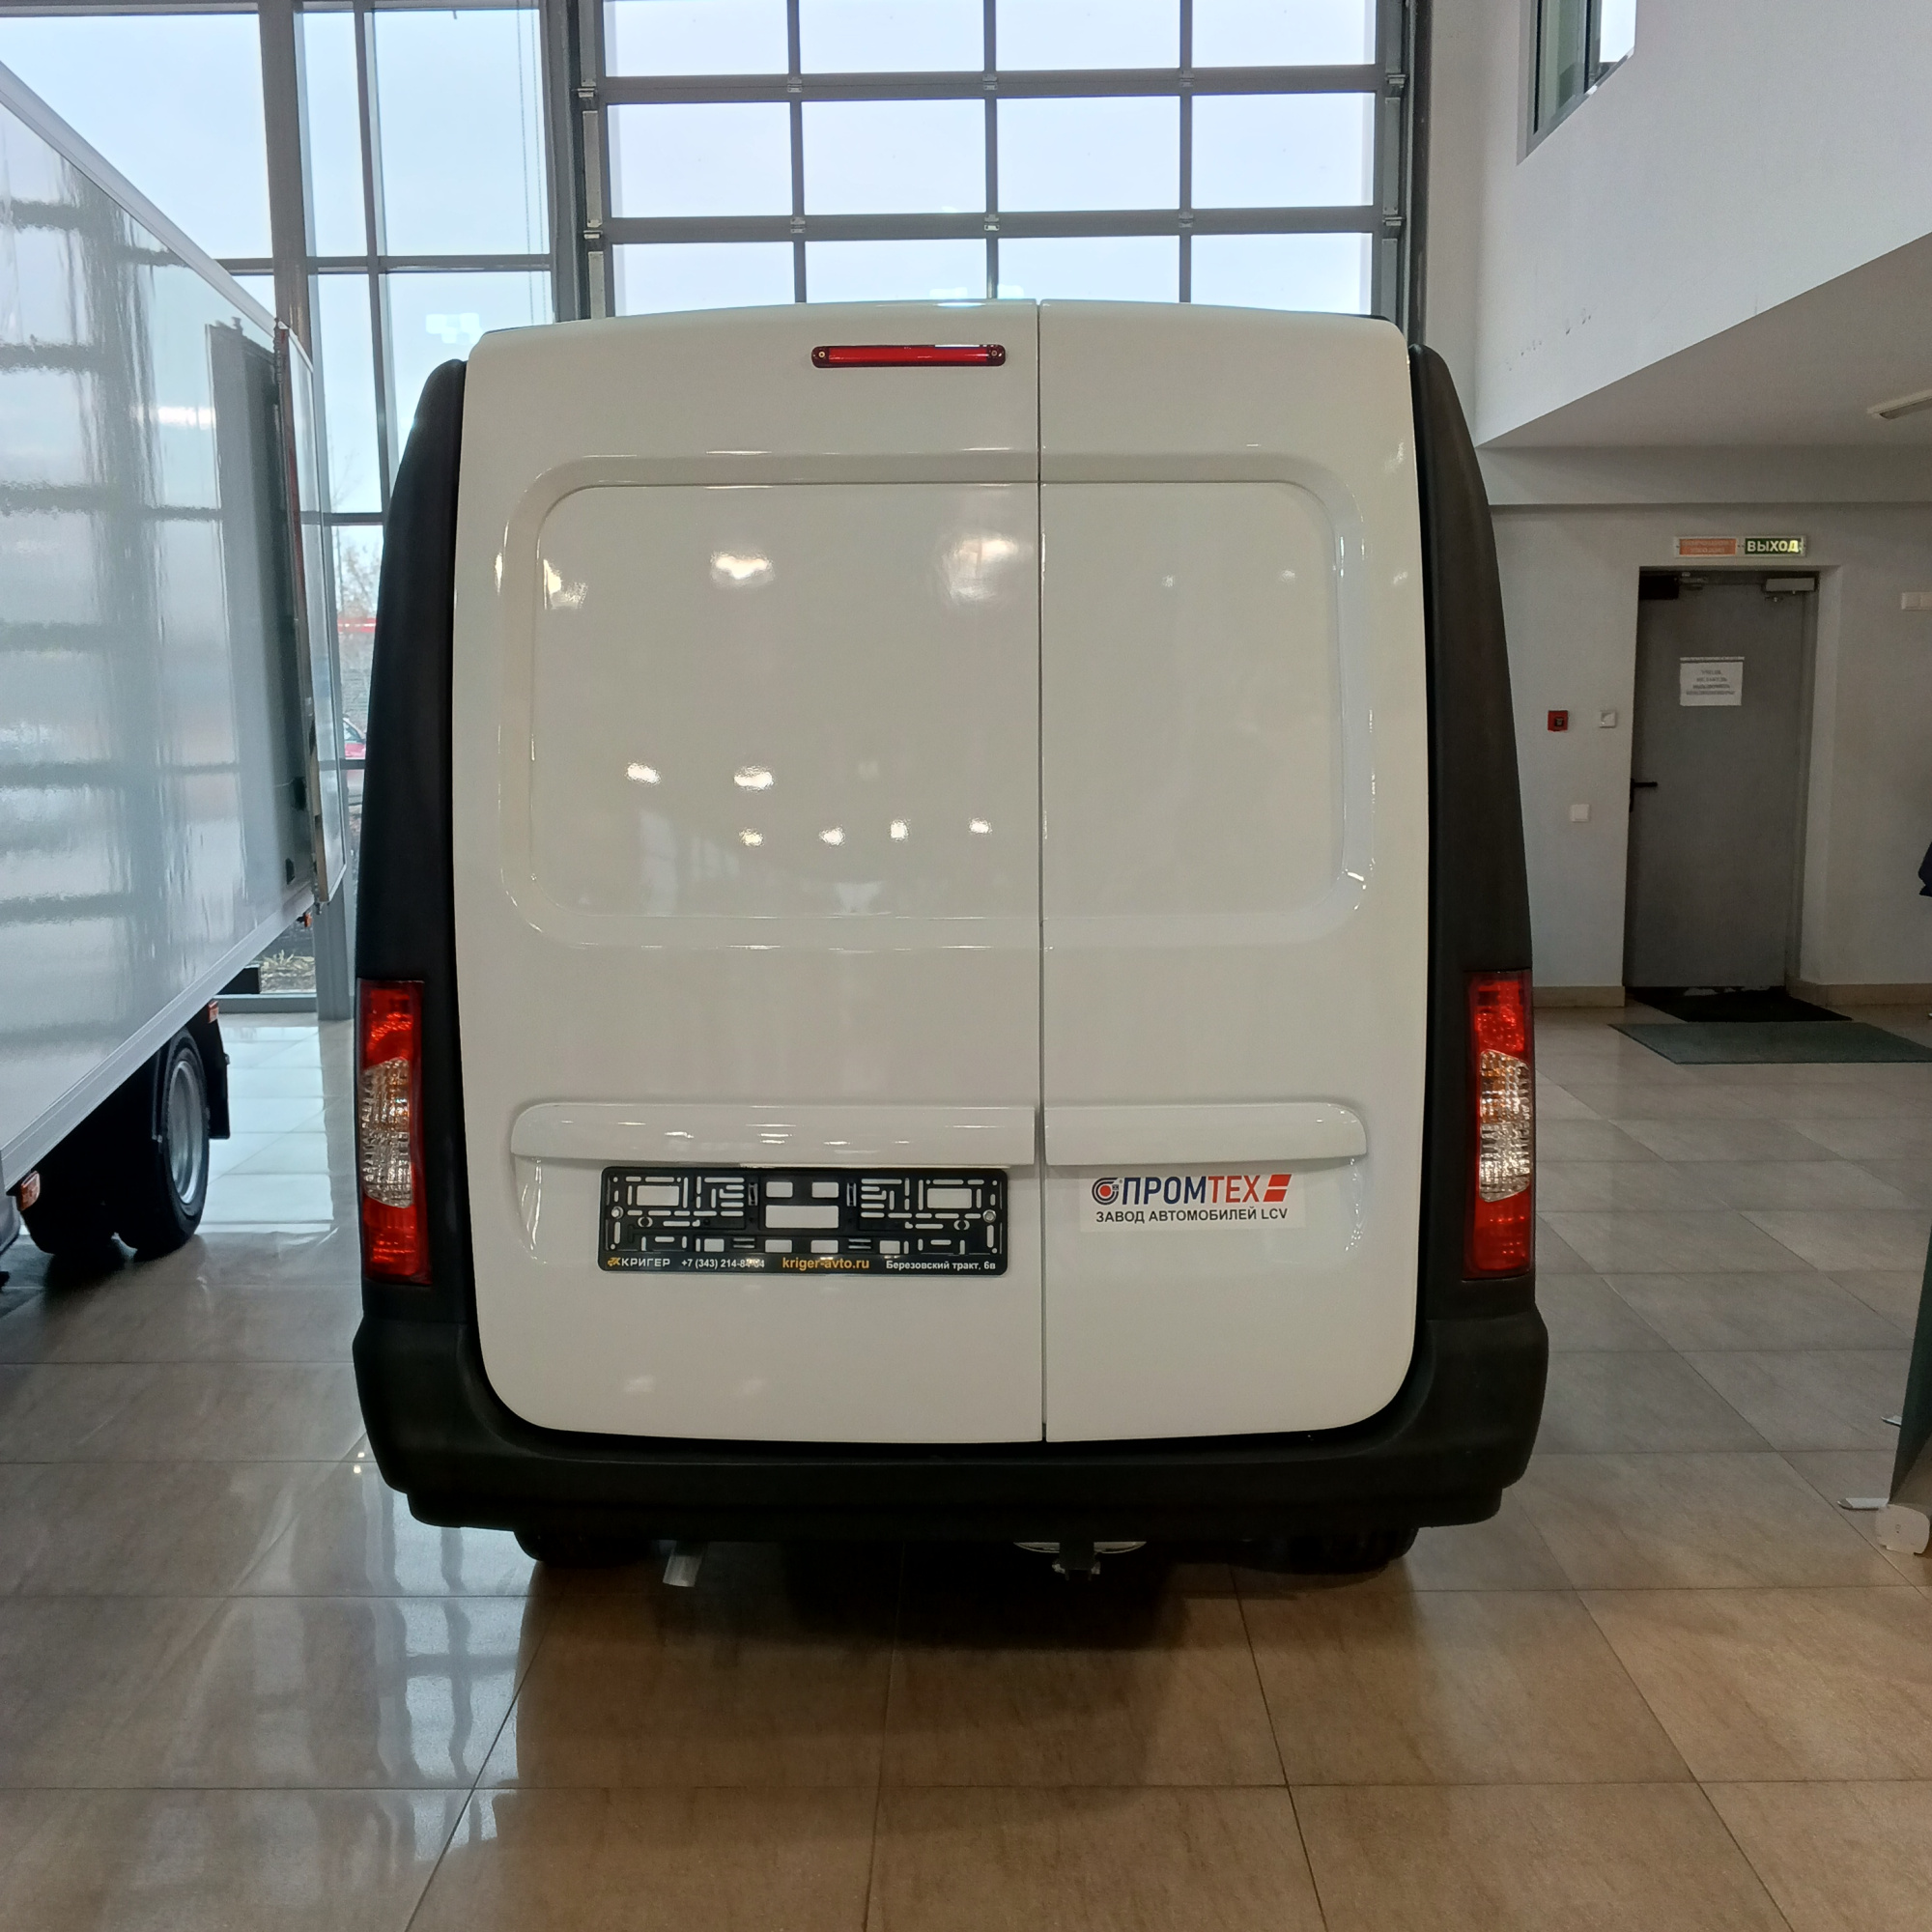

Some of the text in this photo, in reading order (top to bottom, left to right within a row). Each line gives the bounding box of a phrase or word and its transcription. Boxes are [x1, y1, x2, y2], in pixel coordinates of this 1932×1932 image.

[1747, 540, 1799, 553] ВЫХОД
[1122, 1175, 1261, 1205] ПРОМТЕХ
[1095, 1207, 1288, 1224] ЗАВОД АВТОМОБИЛЕЙ LCV
[621, 1258, 670, 1267] КРИГЕР
[681, 1259, 693, 1267] +7
[695, 1258, 719, 1269] (343)
[782, 1257, 869, 1271] kriger-avto.ru
[886, 1260, 950, 1271] Березовский
[952, 1262, 981, 1271] тракт,
